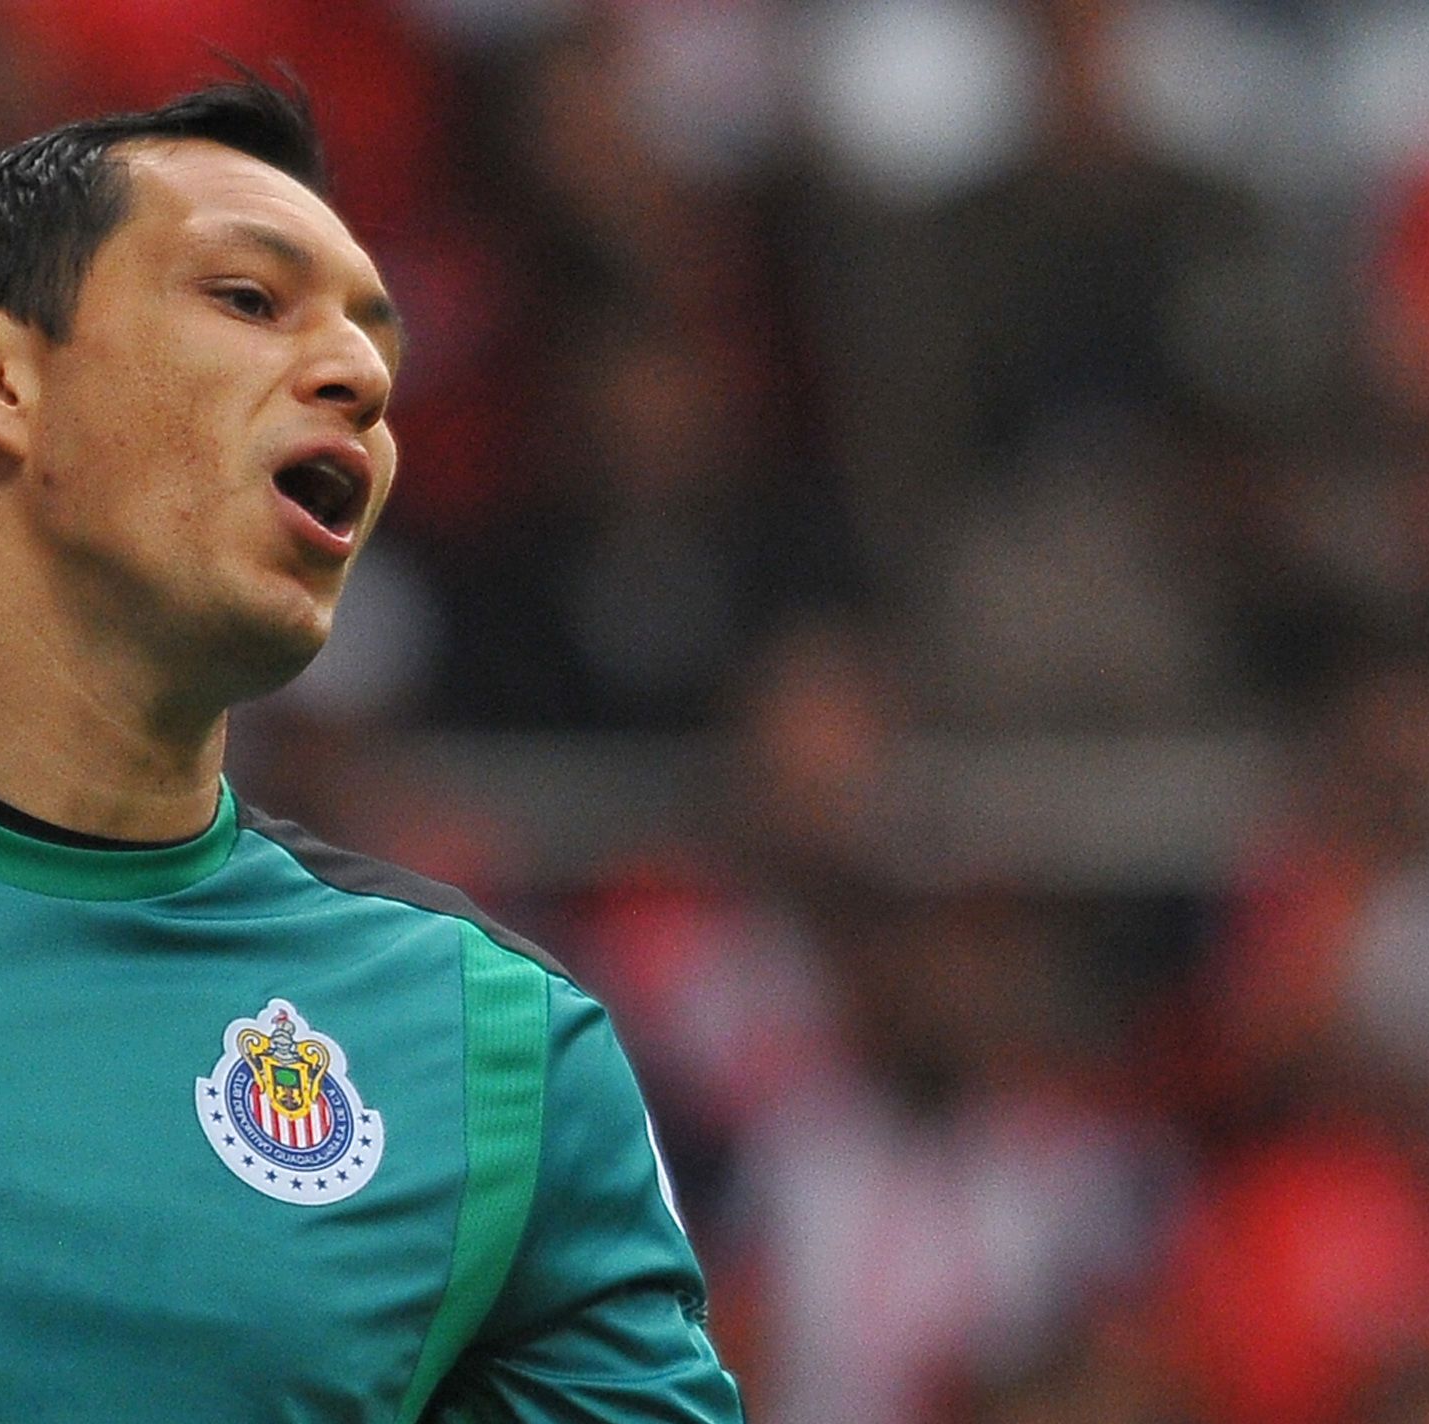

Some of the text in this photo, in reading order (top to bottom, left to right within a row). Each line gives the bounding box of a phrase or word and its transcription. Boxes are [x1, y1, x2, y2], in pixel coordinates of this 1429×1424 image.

[232, 1072, 248, 1098] CLUB
[232, 1099, 273, 1153] DEPORTIVO
[273, 1139, 341, 1165] GUADALAJARA
